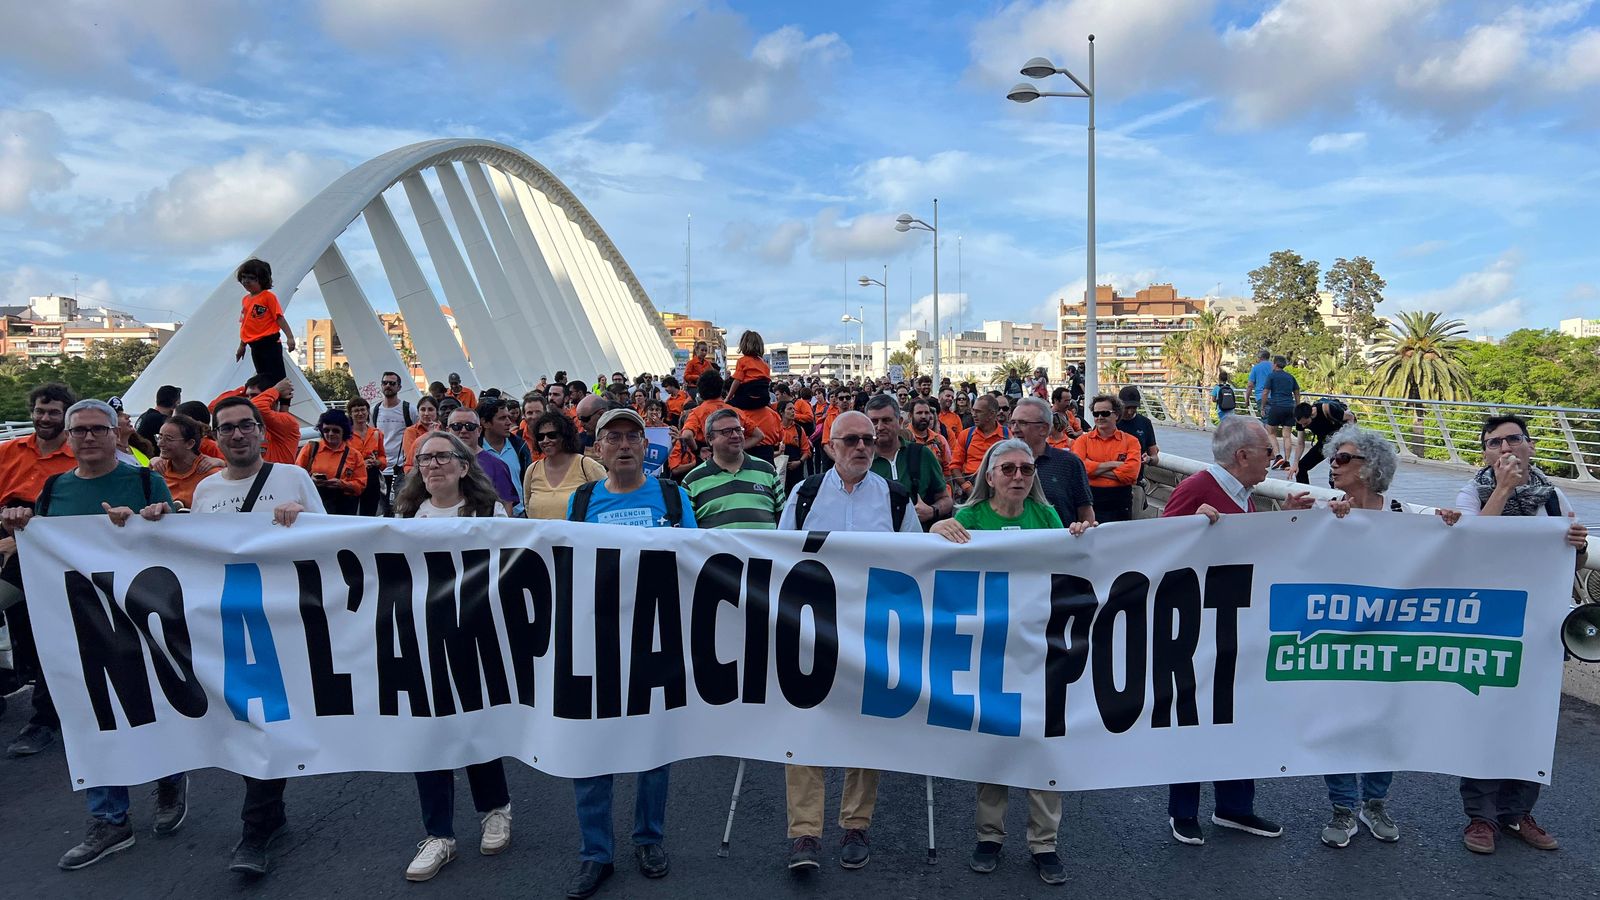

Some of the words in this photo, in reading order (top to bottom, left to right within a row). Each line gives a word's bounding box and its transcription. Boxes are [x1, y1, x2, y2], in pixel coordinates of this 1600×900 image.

[230, 494, 274, 504] VALCIA
[1307, 592, 1481, 624] COMISSIÓ
[64, 566, 208, 730] NO
[220, 562, 290, 722] A
[861, 567, 1022, 737] DEL
[1044, 564, 1254, 738] PORT
